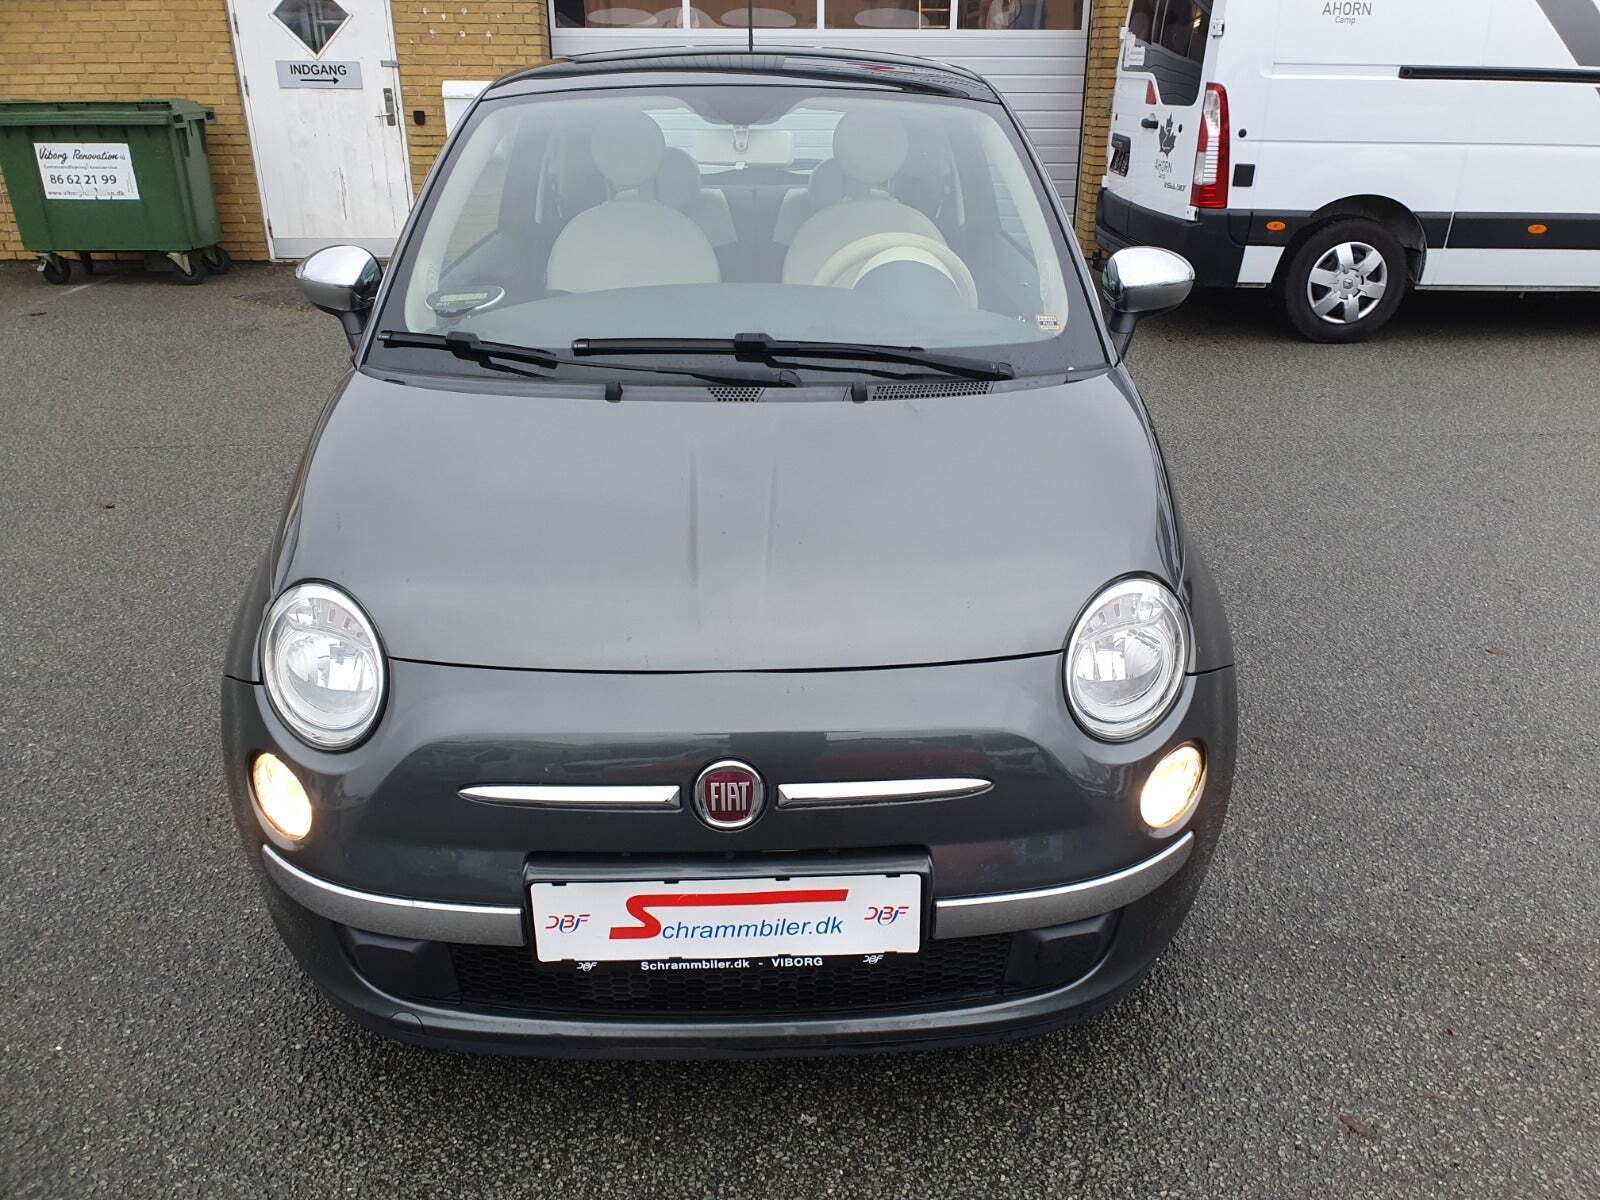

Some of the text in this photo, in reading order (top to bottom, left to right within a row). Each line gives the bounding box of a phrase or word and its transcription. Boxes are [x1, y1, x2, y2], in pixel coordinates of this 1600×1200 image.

[1322, 2, 1372, 16] AHORN
[1335, 16, 1356, 25] Camp
[289, 64, 347, 76] INDGANG
[40, 145, 119, 165] Viborg Renovation
[50, 174, 64, 185] 86
[67, 174, 81, 185] 62
[84, 174, 98, 185] 21
[101, 174, 117, 185] 99
[710, 781, 750, 812] FIAT
[609, 889, 849, 940] Schrammbiler.dk
[641, 957, 750, 971] Schrammbiler.dk
[772, 956, 823, 968] VIBORG
